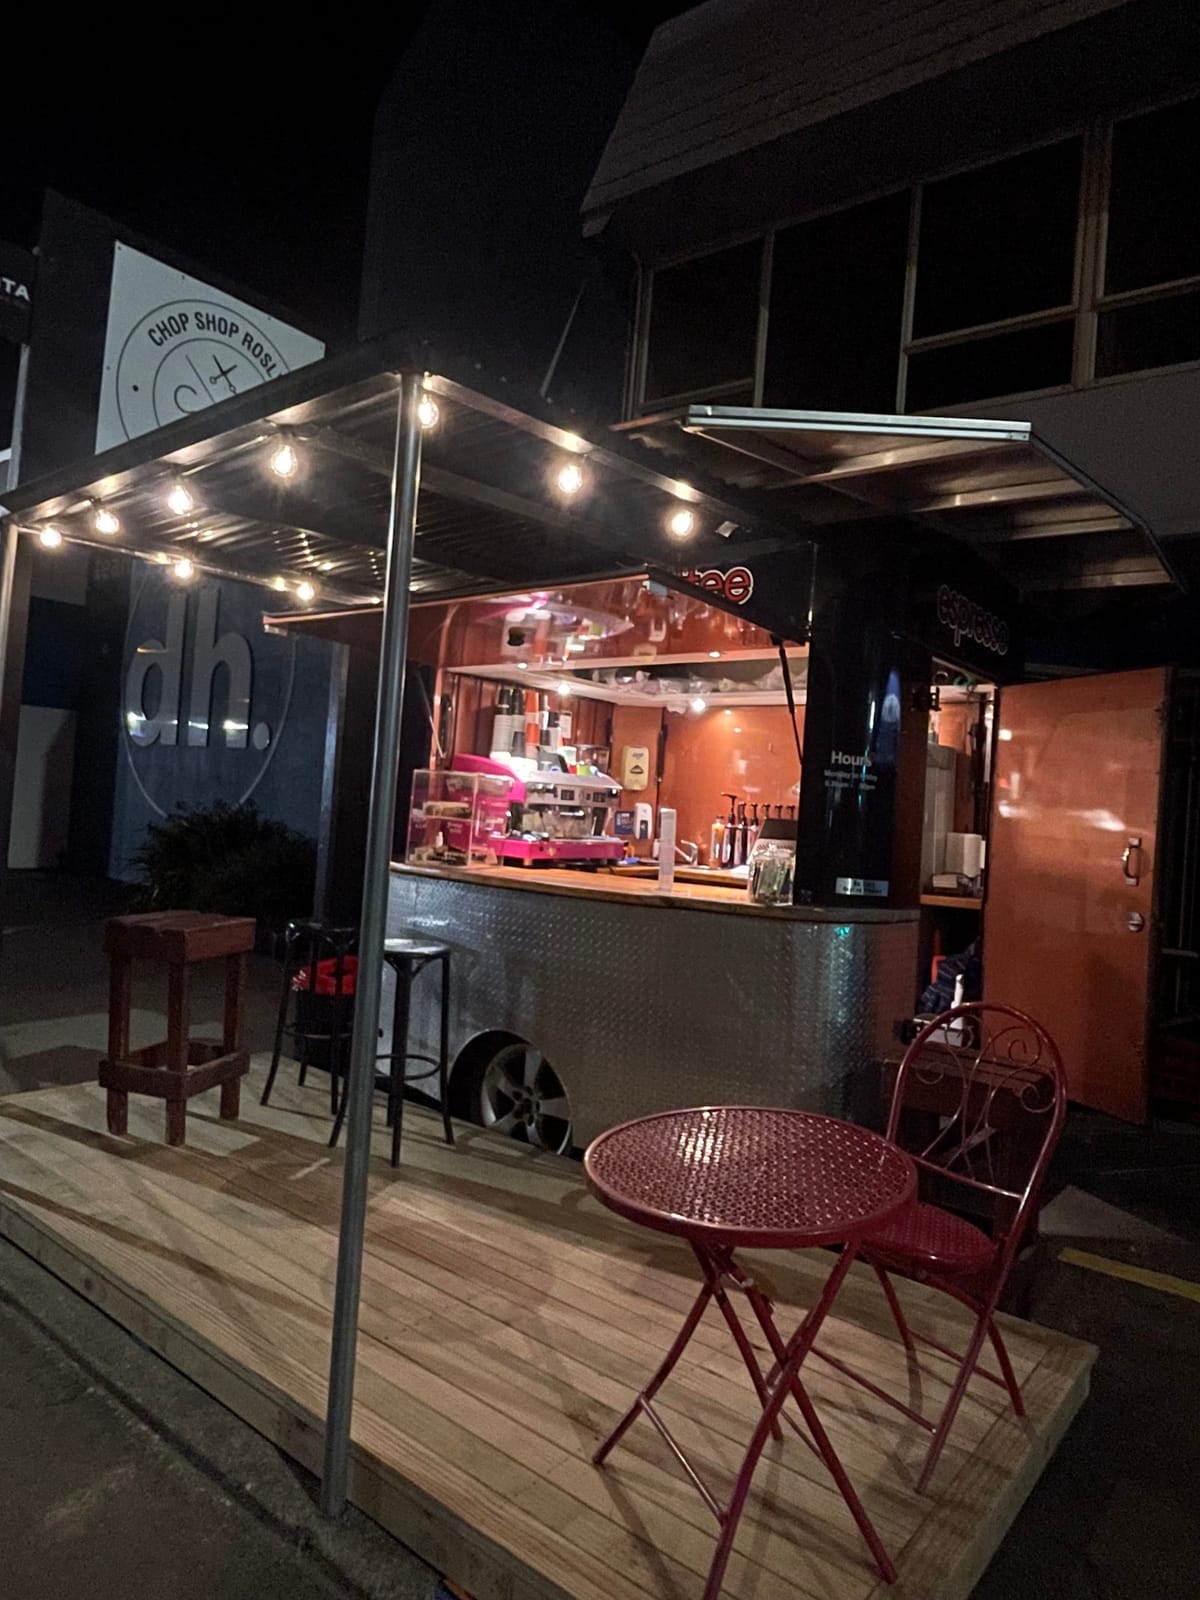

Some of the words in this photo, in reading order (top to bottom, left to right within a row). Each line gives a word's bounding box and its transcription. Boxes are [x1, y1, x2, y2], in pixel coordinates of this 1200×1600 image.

[0, 276, 31, 303] TA
[147, 312, 190, 347] CHOP
[194, 311, 240, 339] SHOP
[241, 331, 283, 378] ROSL
[936, 584, 1009, 657] espresso
[830, 750, 872, 768] Hours
